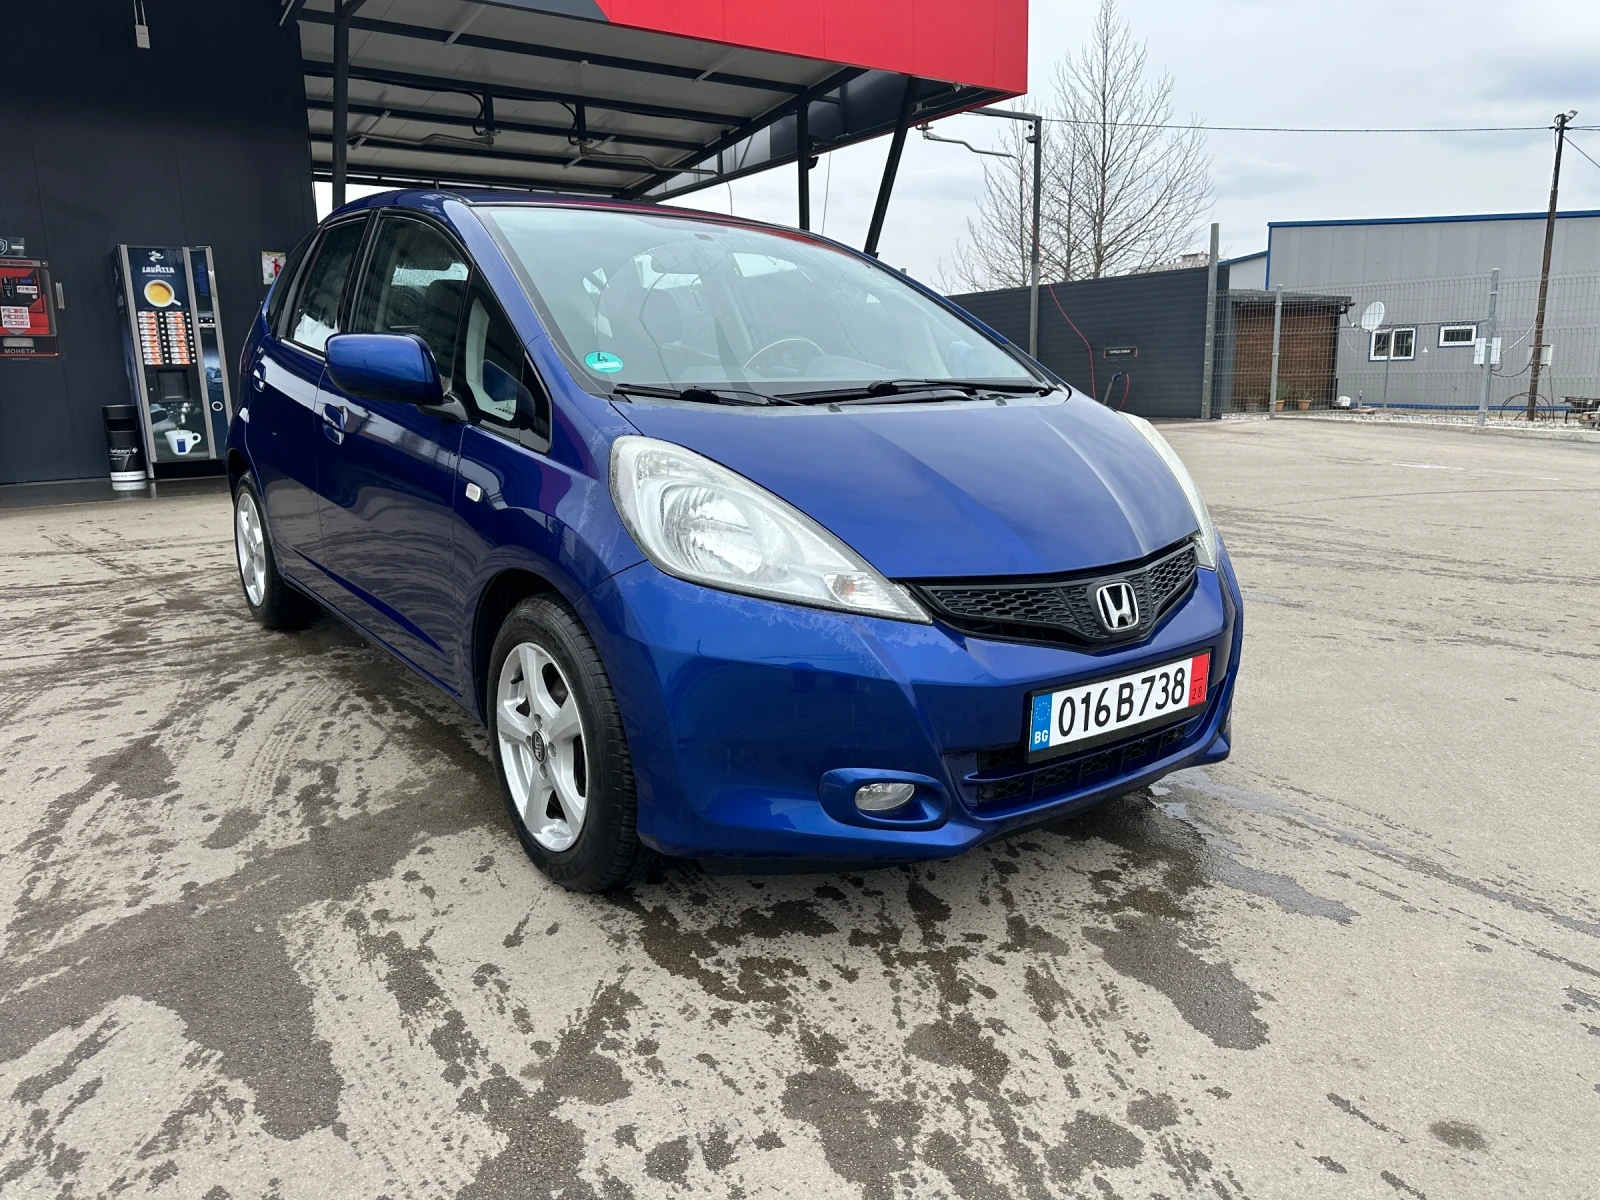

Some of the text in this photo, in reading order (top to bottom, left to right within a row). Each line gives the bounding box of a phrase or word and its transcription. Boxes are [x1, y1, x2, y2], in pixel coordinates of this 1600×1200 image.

[142, 264, 175, 274] LAVAZZA
[597, 352, 608, 362] 4
[1034, 667, 1203, 745] BG 016B738 28
